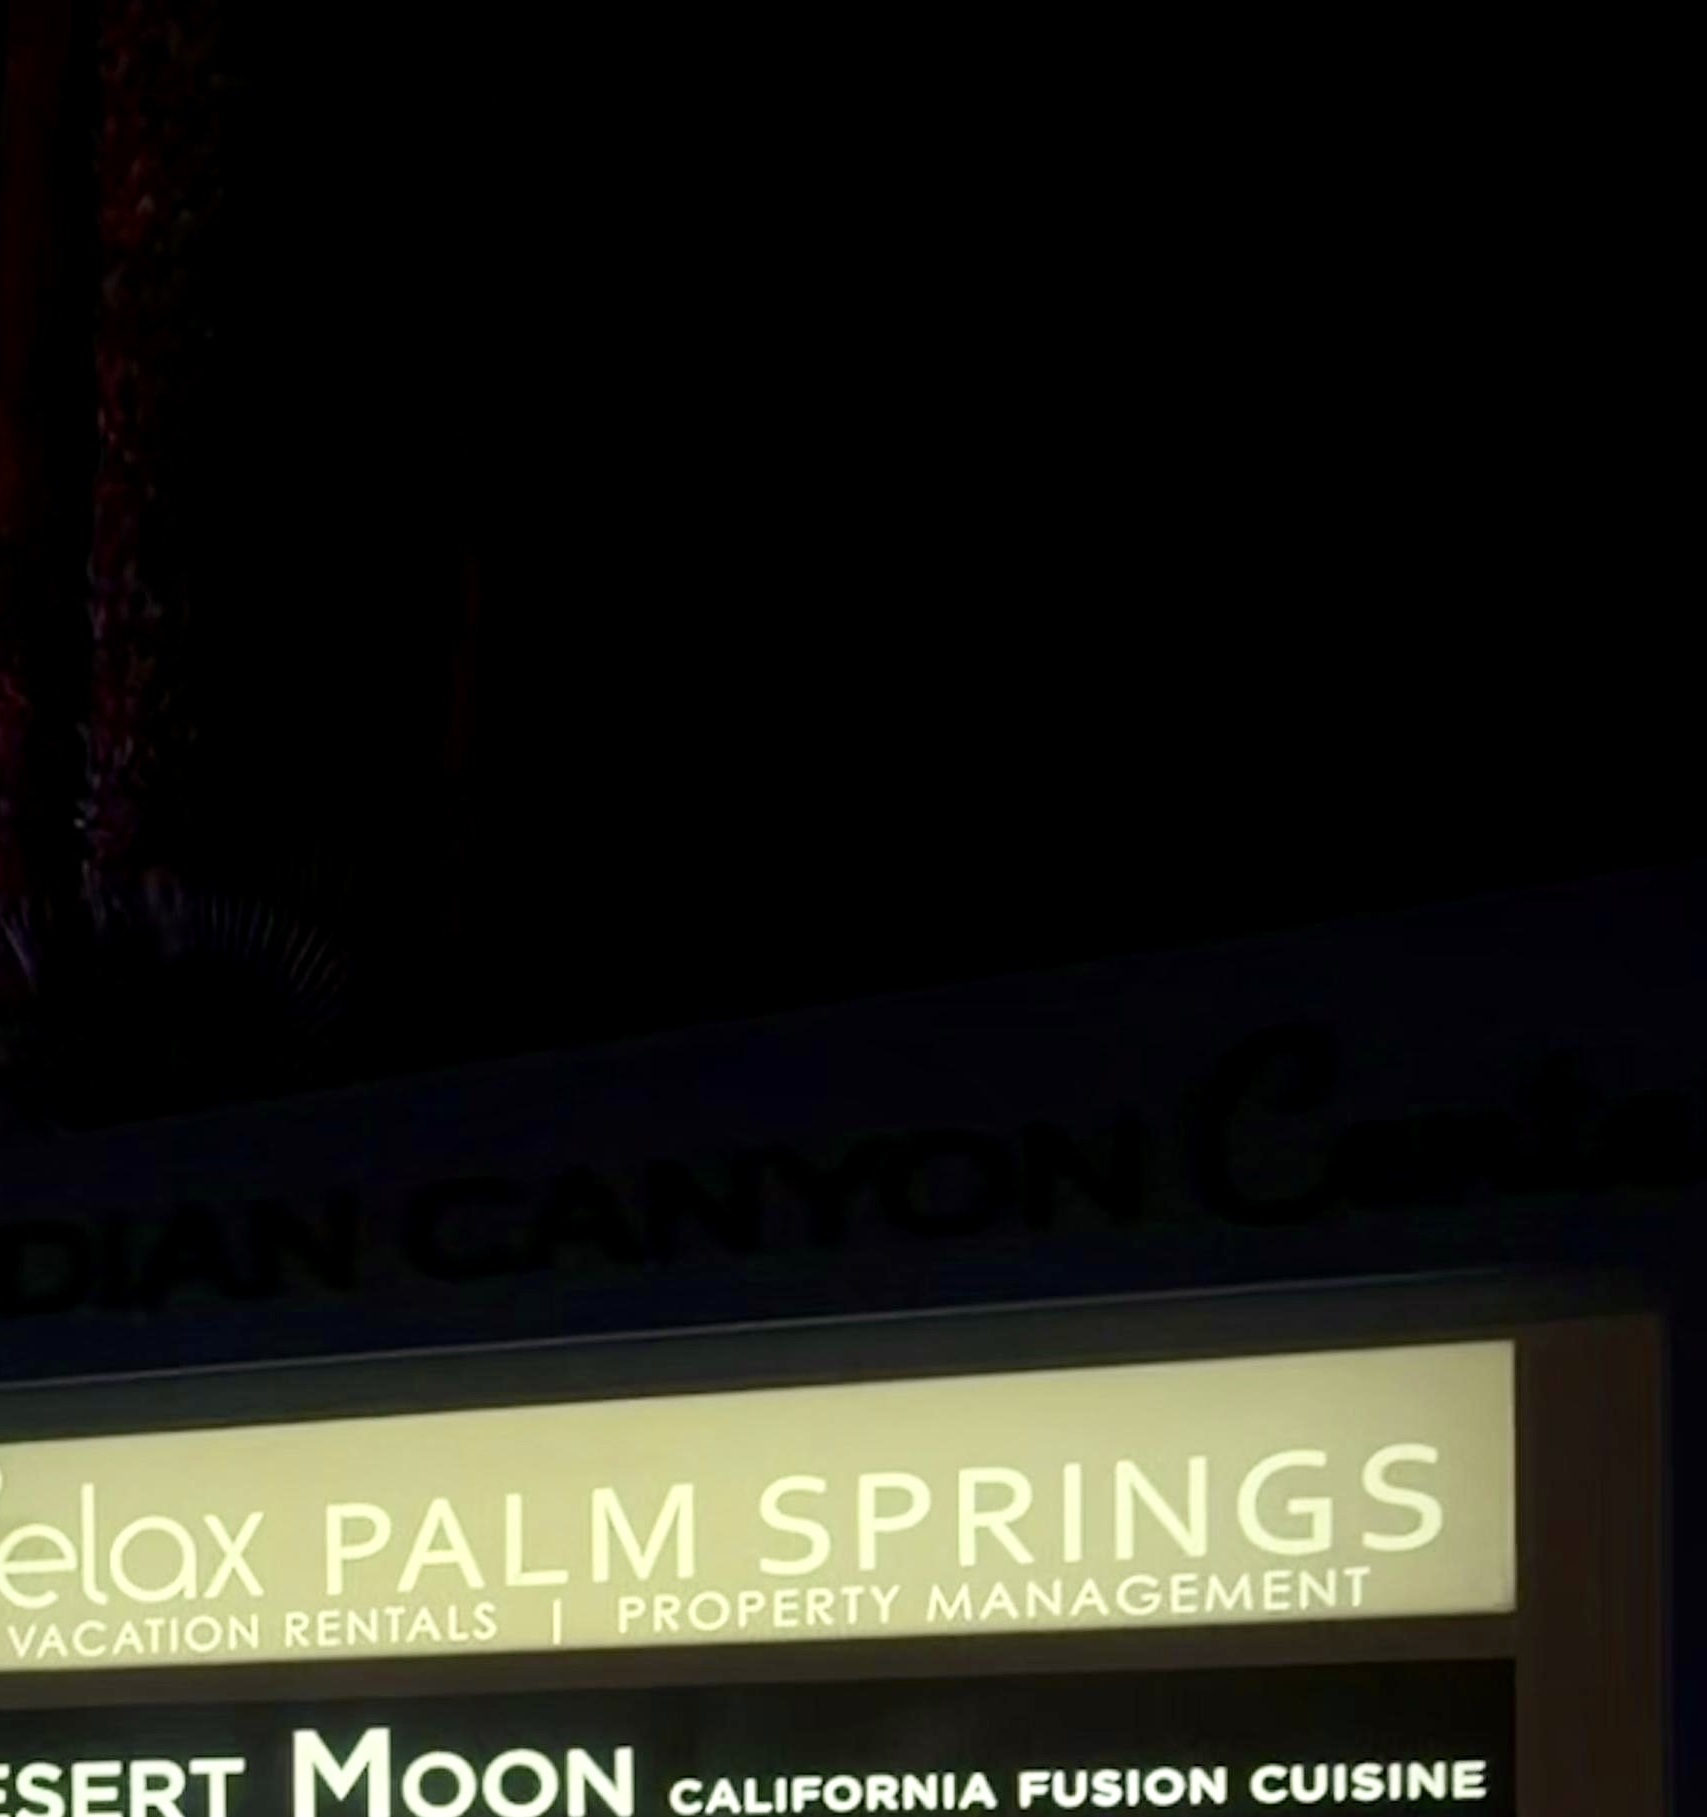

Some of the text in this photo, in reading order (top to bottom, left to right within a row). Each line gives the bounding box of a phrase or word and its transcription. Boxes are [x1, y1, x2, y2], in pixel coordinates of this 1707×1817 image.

[413, 1108, 1147, 1282] CANYON
[325, 1482, 695, 1596] PALM
[758, 1442, 1444, 1577] SPRINGS
[8, 1613, 261, 1660] VACATION
[284, 1601, 499, 1648] RENTALS
[618, 1584, 901, 1635] PROPERTY
[926, 1566, 1371, 1623] MANAGEMENT
[669, 1771, 998, 1817] CALIFORNIA
[1017, 1765, 1228, 1811] FUSION
[1249, 1759, 1488, 1804] CUISINE
